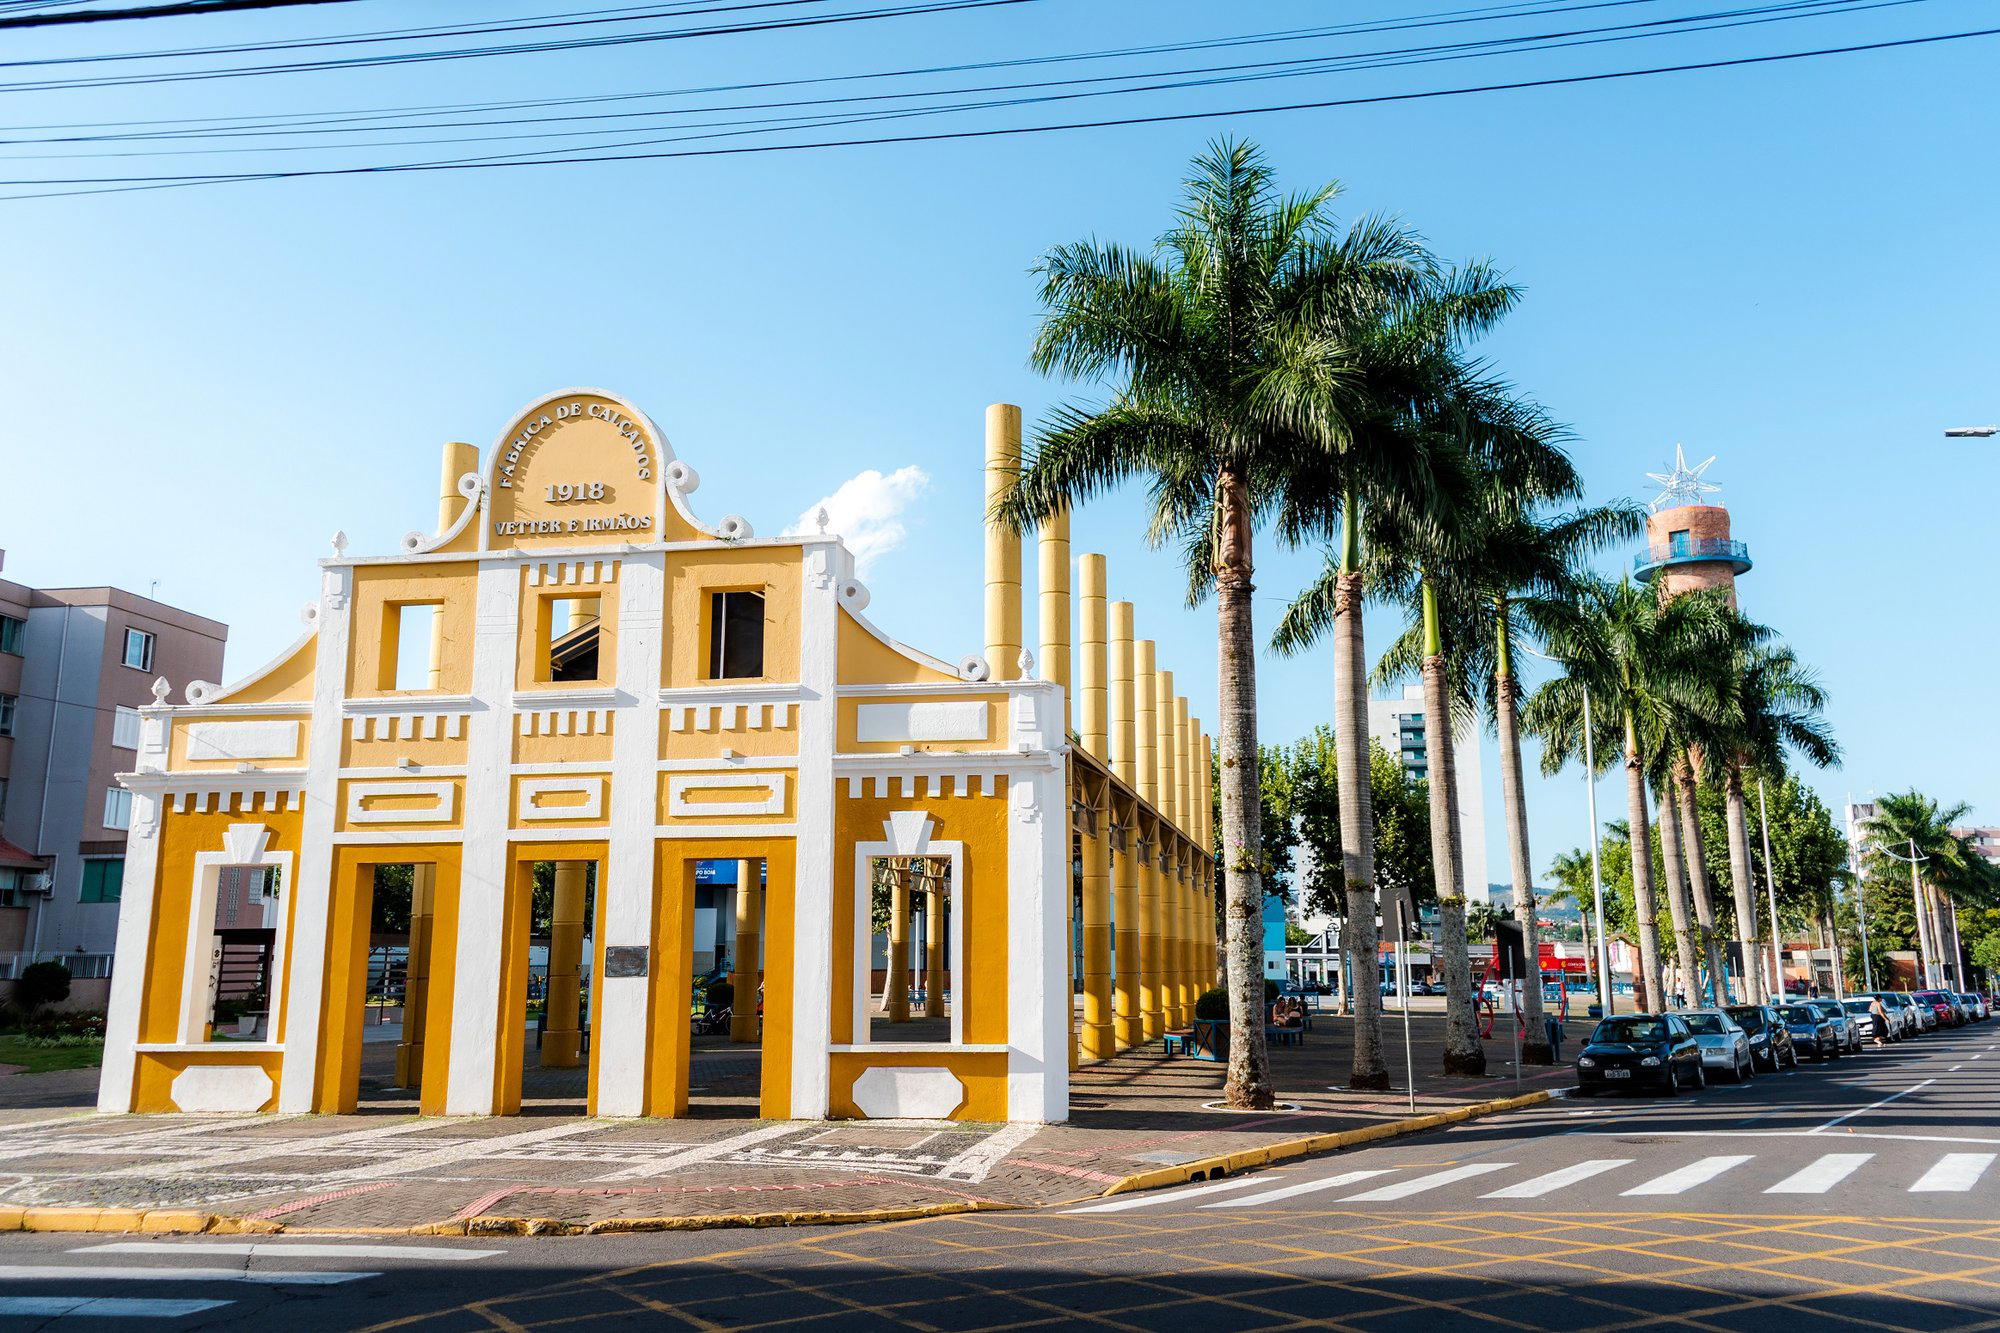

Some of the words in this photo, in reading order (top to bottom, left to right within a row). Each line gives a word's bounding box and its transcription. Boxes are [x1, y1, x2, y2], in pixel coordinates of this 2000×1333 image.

[499, 414, 553, 489] FÁBRICA
[556, 402, 582, 420] DE
[587, 402, 651, 480] CALÇADOS
[544, 480, 605, 503] 1918
[495, 519, 562, 536] VETTER
[567, 519, 579, 532] E
[583, 514, 652, 532] IRMÃOS
